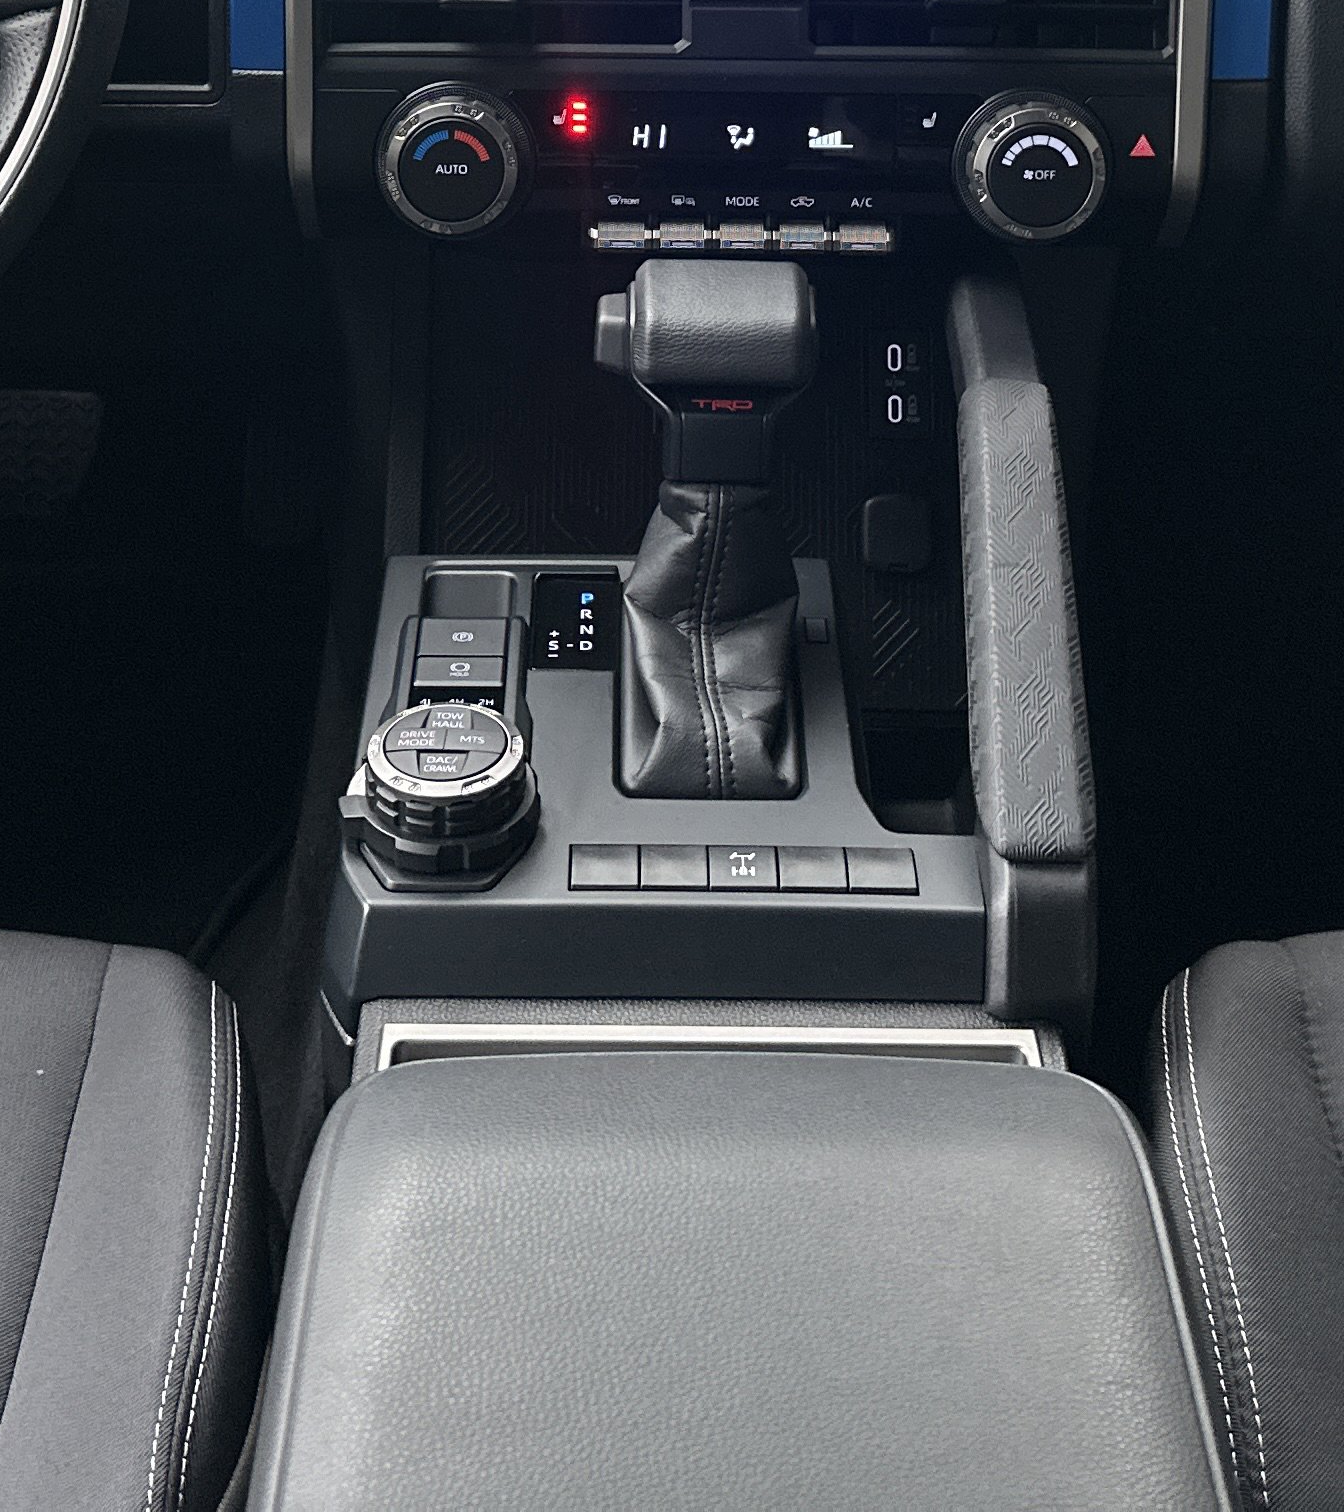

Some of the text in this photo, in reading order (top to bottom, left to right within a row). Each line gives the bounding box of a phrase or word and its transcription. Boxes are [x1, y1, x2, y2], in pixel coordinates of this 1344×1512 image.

[435, 164, 468, 175] AUTO
[1034, 169, 1056, 180] OFF
[620, 197, 641, 206] FRONT
[725, 196, 760, 207] MODE
[850, 197, 873, 208] A/C
[691, 399, 753, 412] TRD
[581, 592, 594, 605] P
[580, 608, 594, 619] R
[579, 624, 594, 635] N
[579, 640, 593, 651] D
[435, 711, 465, 720] TOW
[432, 720, 465, 729] HAUL
[399, 730, 436, 738] DRIVE
[459, 735, 486, 744] MTS
[398, 738, 435, 747] MODE
[426, 755, 458, 764] DAC/
[423, 764, 459, 773] CRAWL
